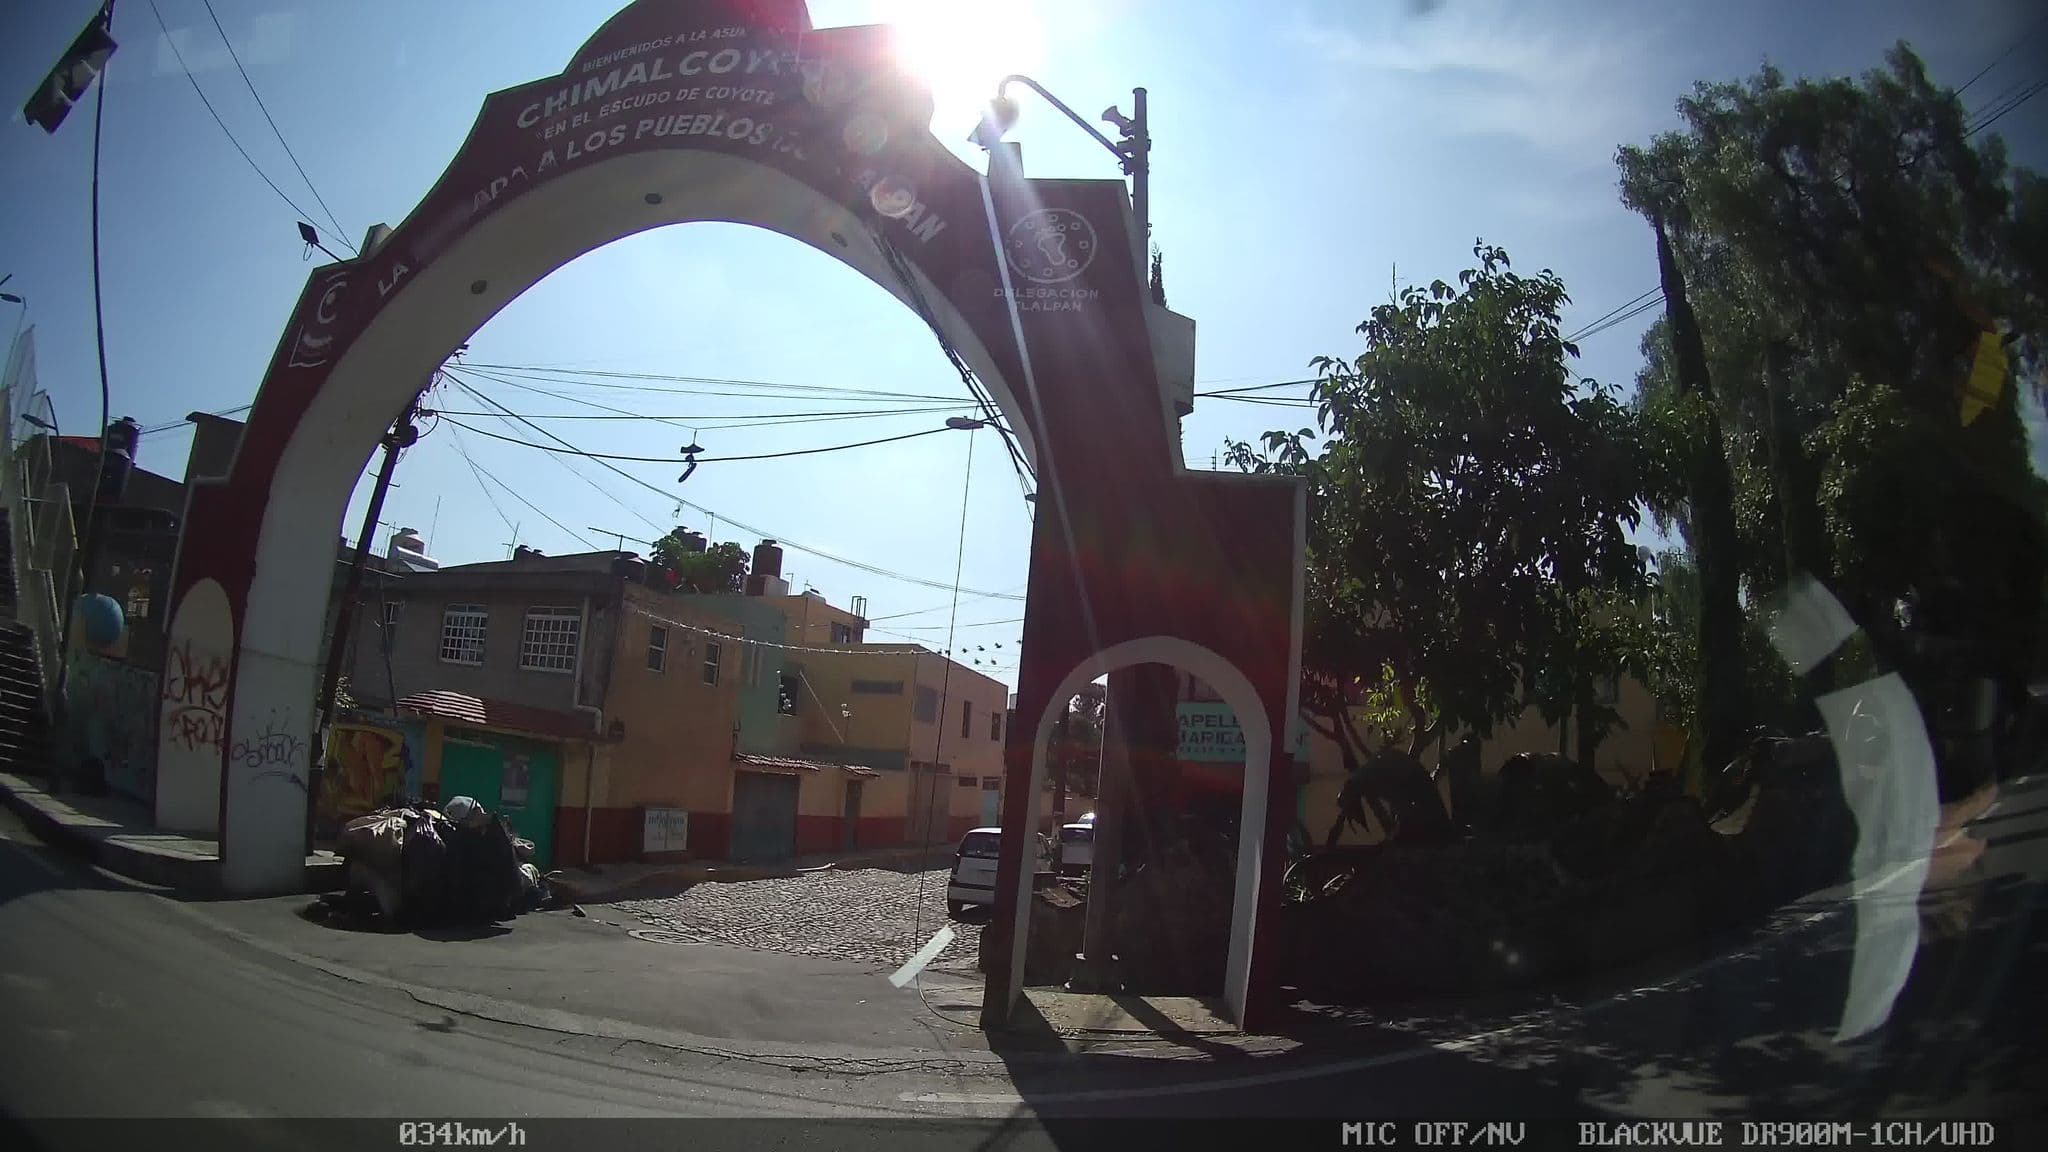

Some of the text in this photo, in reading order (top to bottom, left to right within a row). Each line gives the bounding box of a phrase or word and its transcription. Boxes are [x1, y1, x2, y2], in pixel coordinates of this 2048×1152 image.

[582, 37, 673, 72] BIENVENIDOS
[675, 33, 686, 43] A
[690, 30, 707, 41] LA
[571, 112, 592, 128] EL
[600, 91, 671, 118] ESCUDO
[677, 87, 701, 100] DE
[705, 86, 777, 105] COYOTE
[377, 262, 409, 296] LA
[537, 149, 556, 173] A
[567, 124, 626, 160] LOS
[634, 113, 775, 145] PUEBLOS
[993, 288, 1098, 299] DLEGACION
